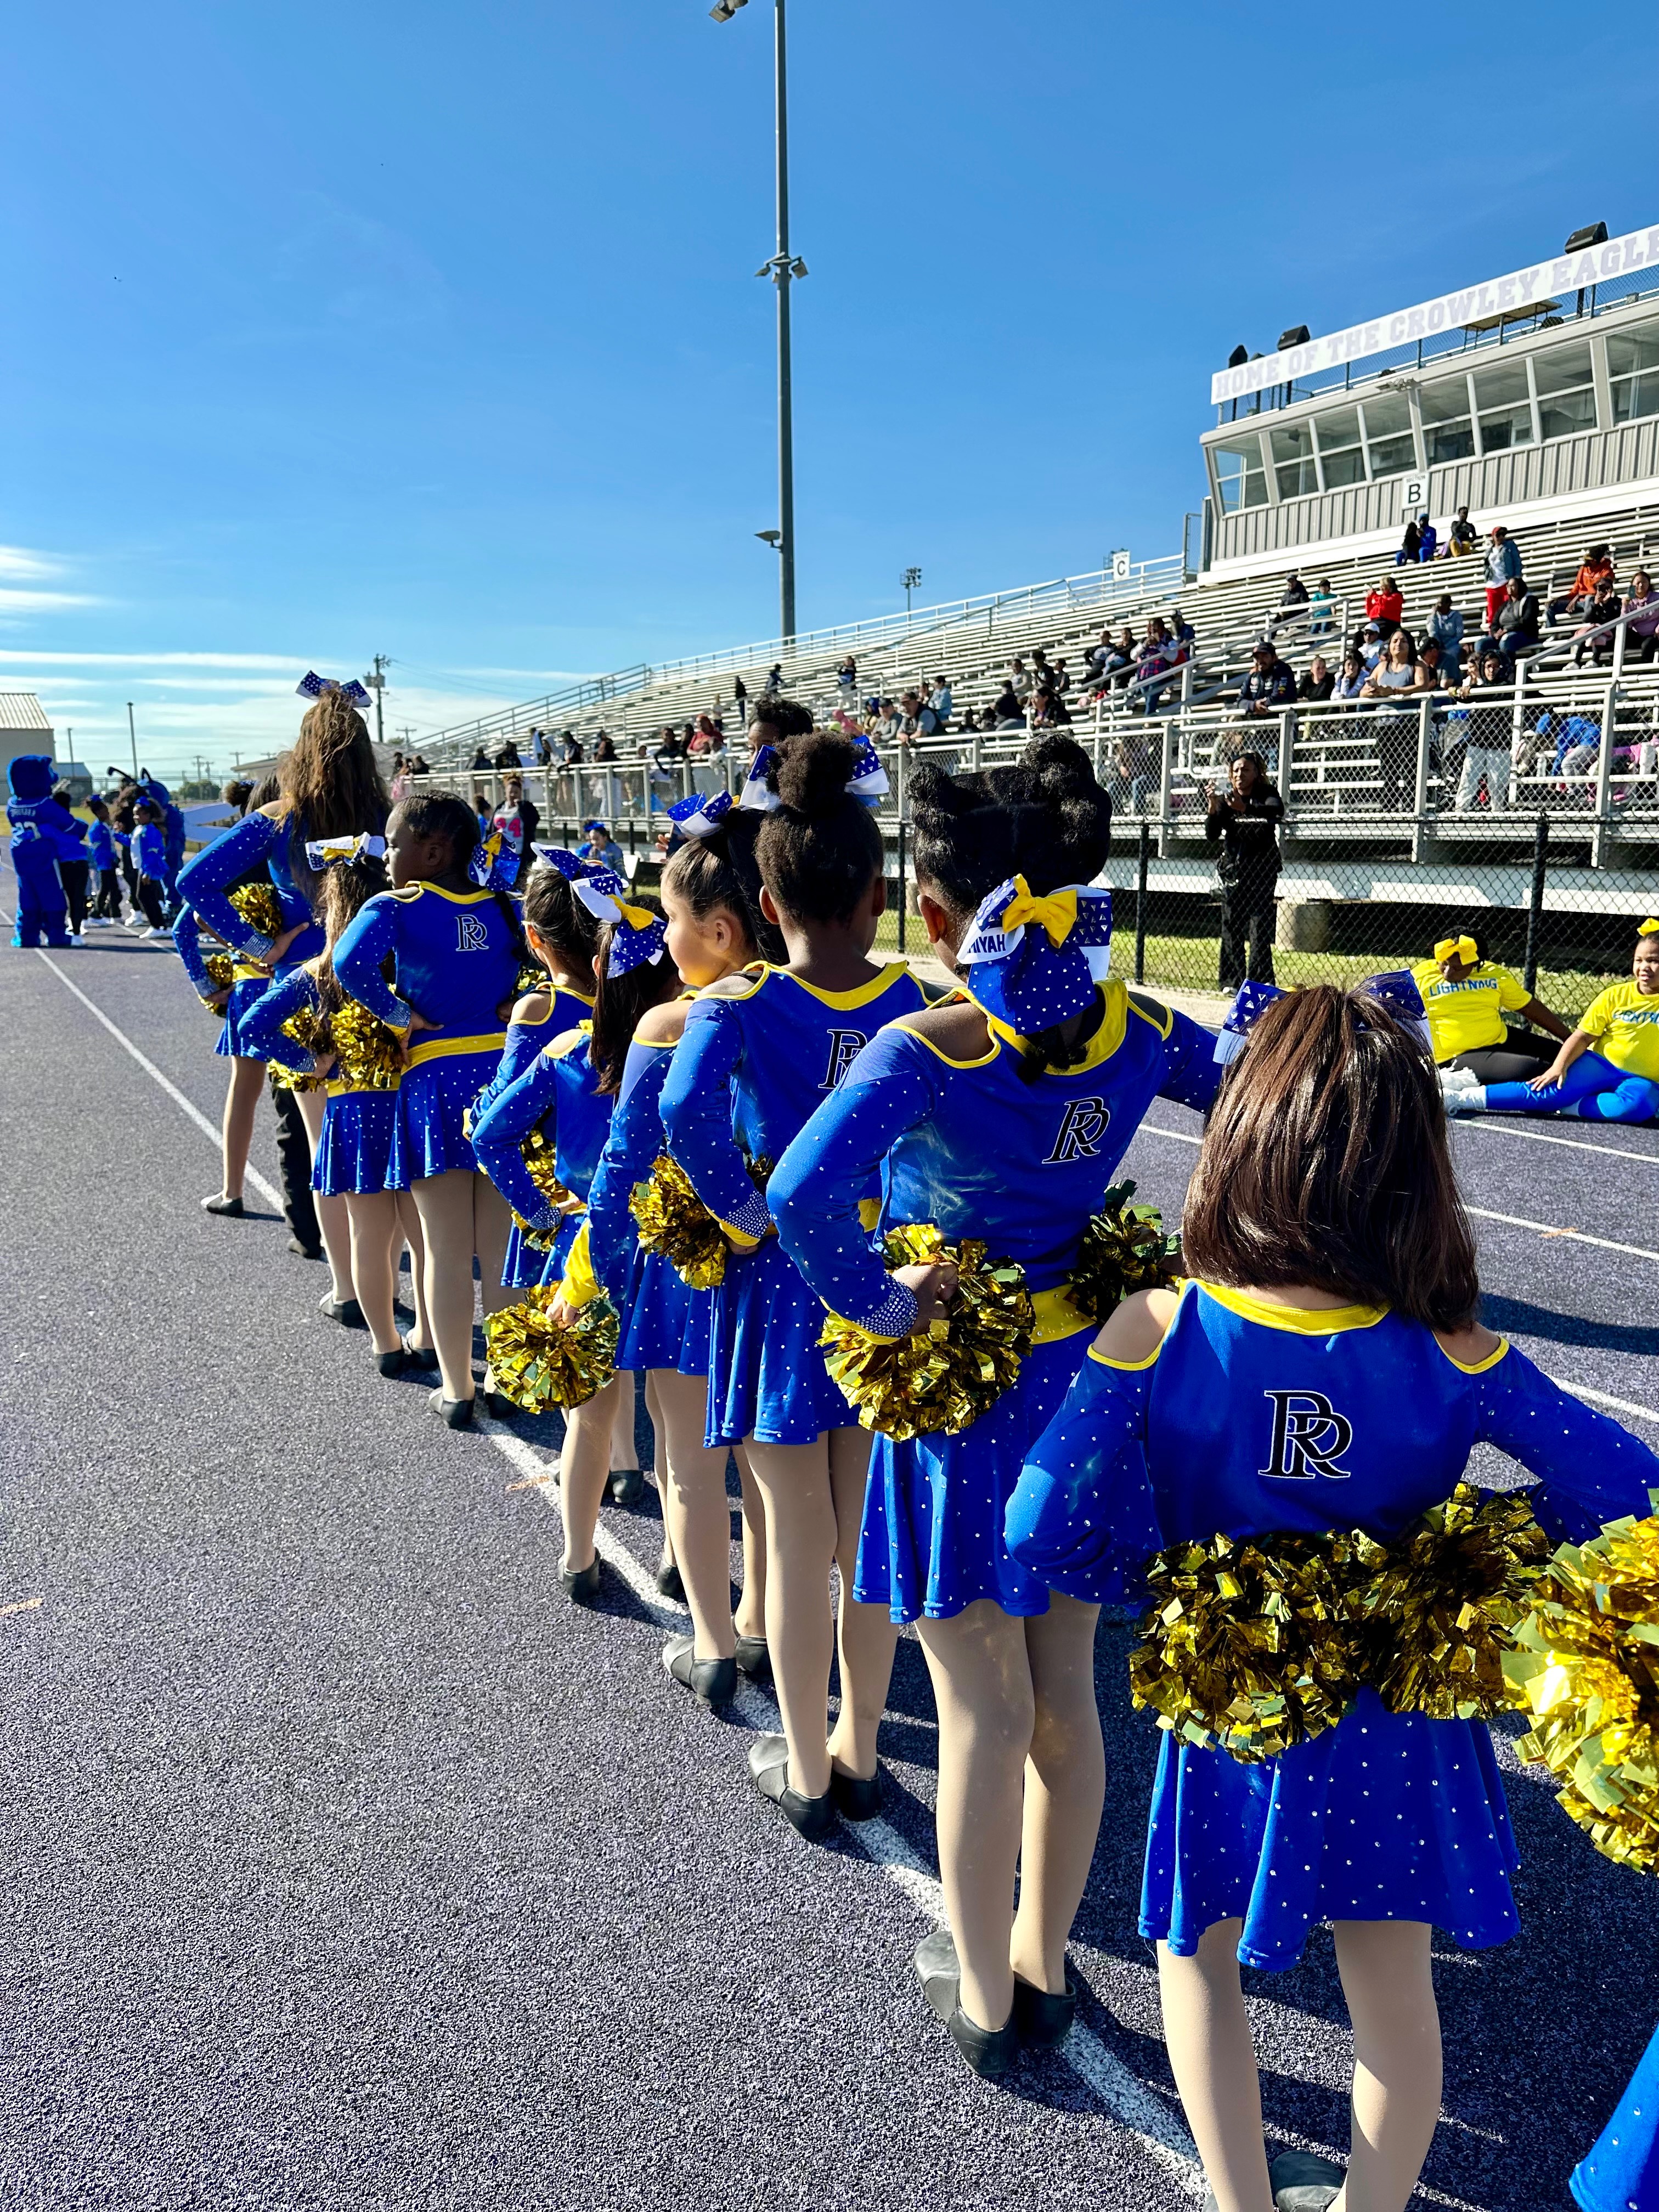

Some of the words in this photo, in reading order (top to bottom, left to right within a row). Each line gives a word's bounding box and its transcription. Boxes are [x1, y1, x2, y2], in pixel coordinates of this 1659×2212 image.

[1216, 357, 1279, 400] HOME
[1289, 343, 1318, 375] OF
[1327, 322, 1380, 363] THE
[1390, 269, 1540, 343] CROWLEY
[1408, 483, 1421, 504] B
[1117, 560, 1126, 576] C
